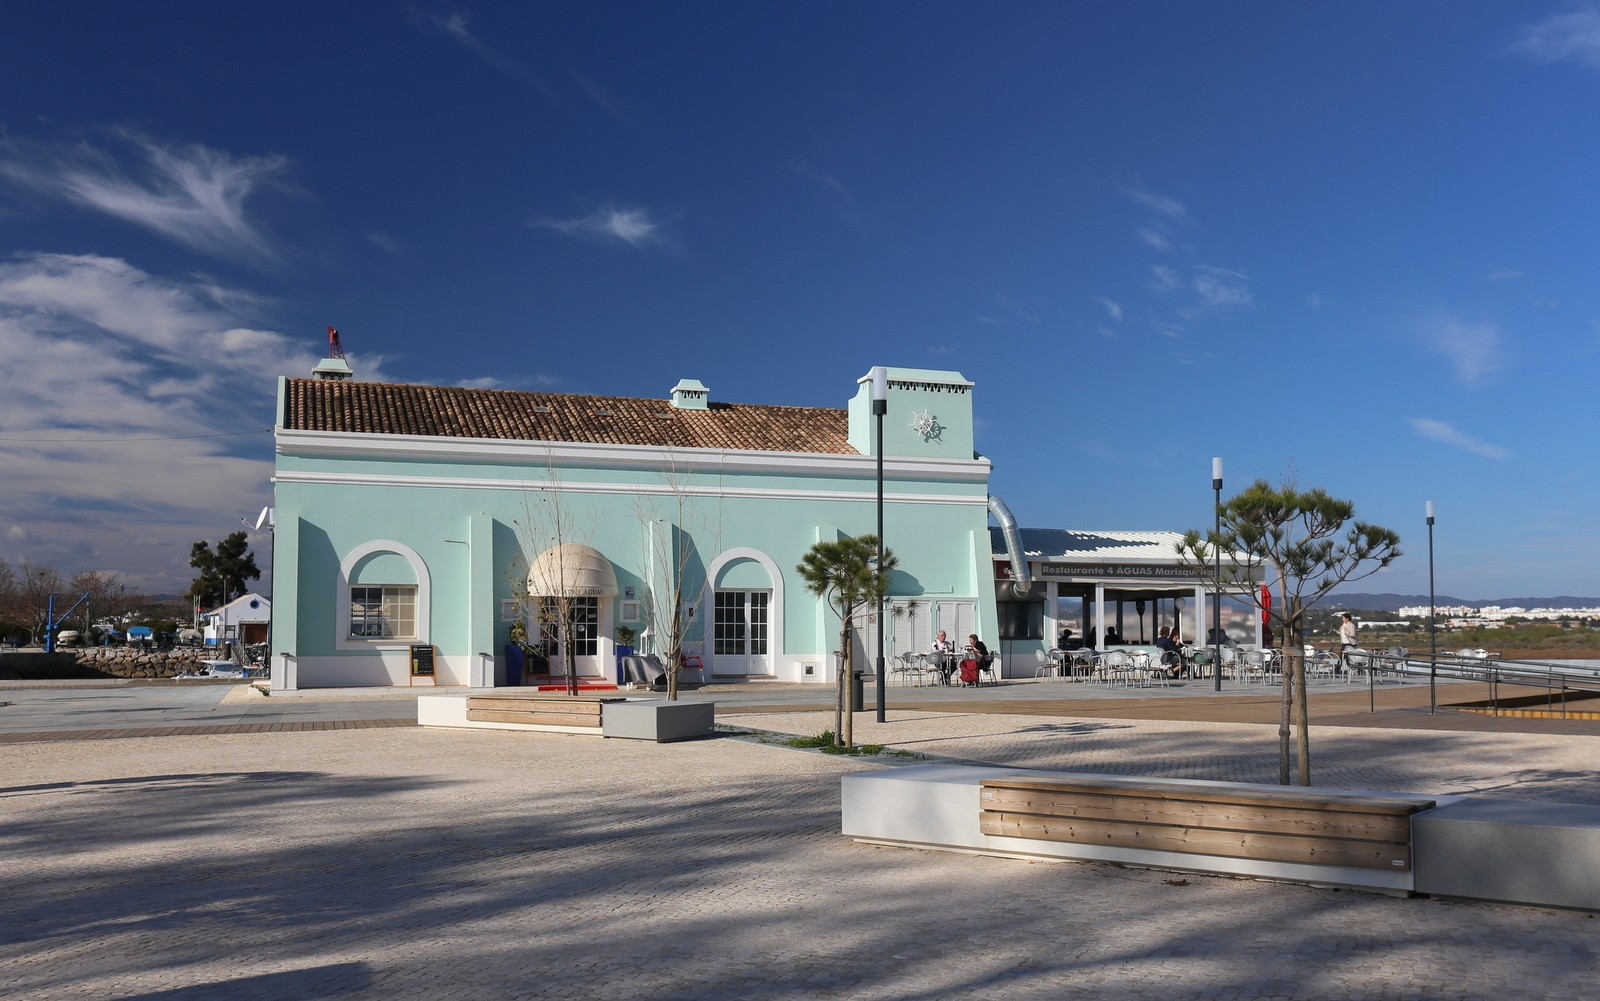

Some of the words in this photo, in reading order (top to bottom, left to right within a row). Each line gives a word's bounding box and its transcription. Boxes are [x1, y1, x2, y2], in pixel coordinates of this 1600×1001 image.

[1042, 565, 1104, 575] Restaurante
[1107, 567, 1114, 575] 4
[1155, 567, 1214, 577] Marisquira
